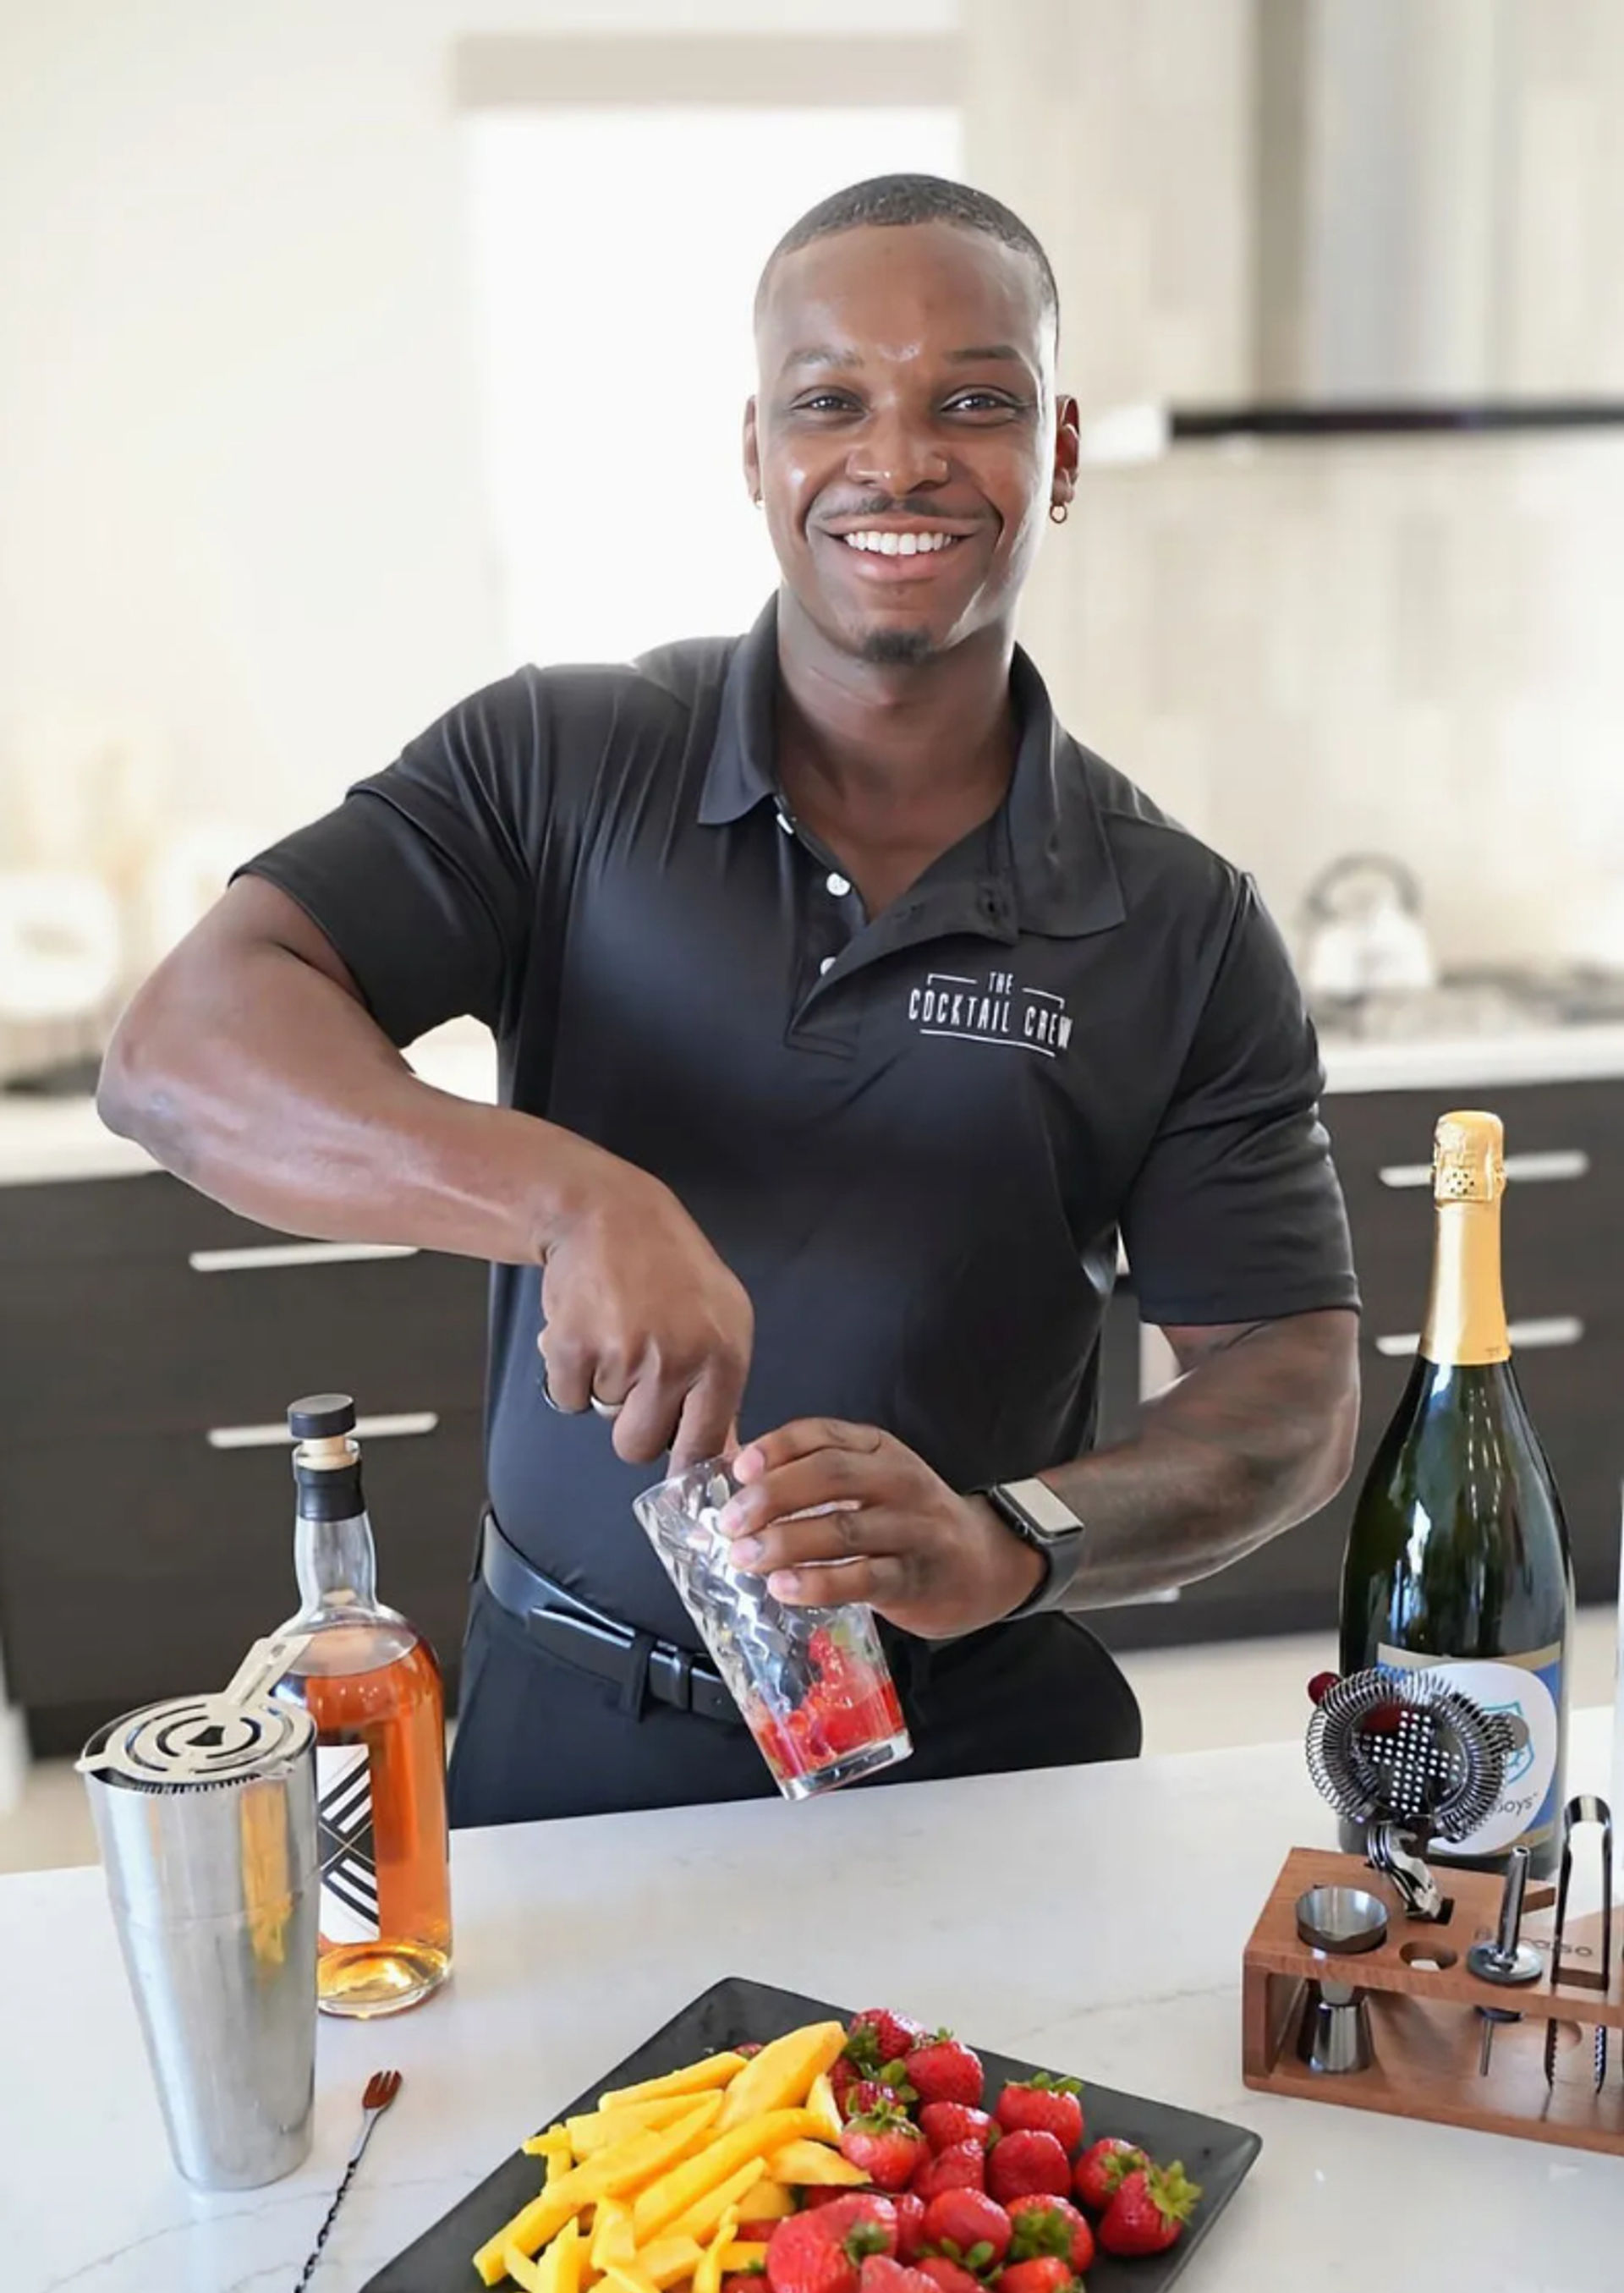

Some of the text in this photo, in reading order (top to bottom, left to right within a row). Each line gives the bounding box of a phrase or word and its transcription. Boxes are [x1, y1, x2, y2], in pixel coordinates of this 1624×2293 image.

[989, 971, 1013, 995] THE
[908, 989, 1073, 1050] COCKTAIL CREW
